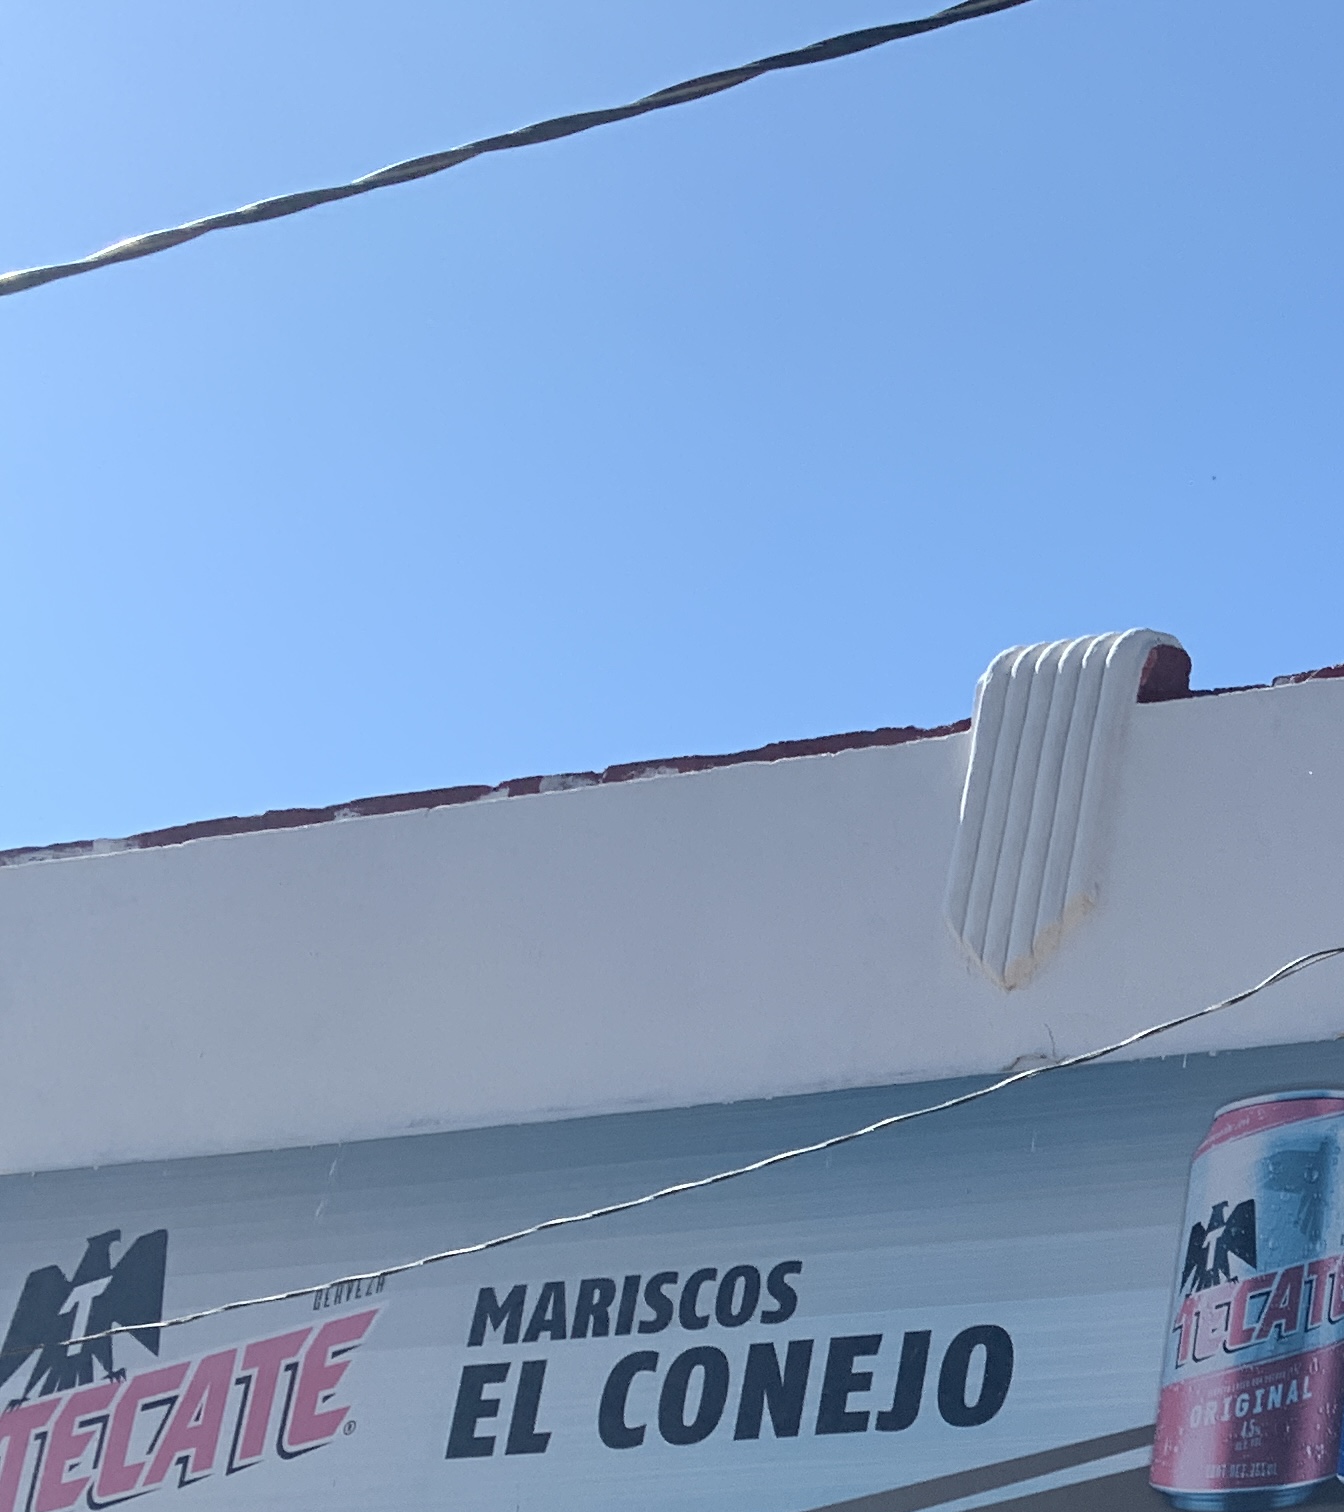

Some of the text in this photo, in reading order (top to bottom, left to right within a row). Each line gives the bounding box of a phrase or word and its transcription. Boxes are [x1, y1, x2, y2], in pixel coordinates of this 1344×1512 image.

[466, 1259, 803, 1348] MARISCOS
[444, 1324, 1014, 1460] EL CONEJO
[1189, 1375, 1313, 1429] ORIGINAL
